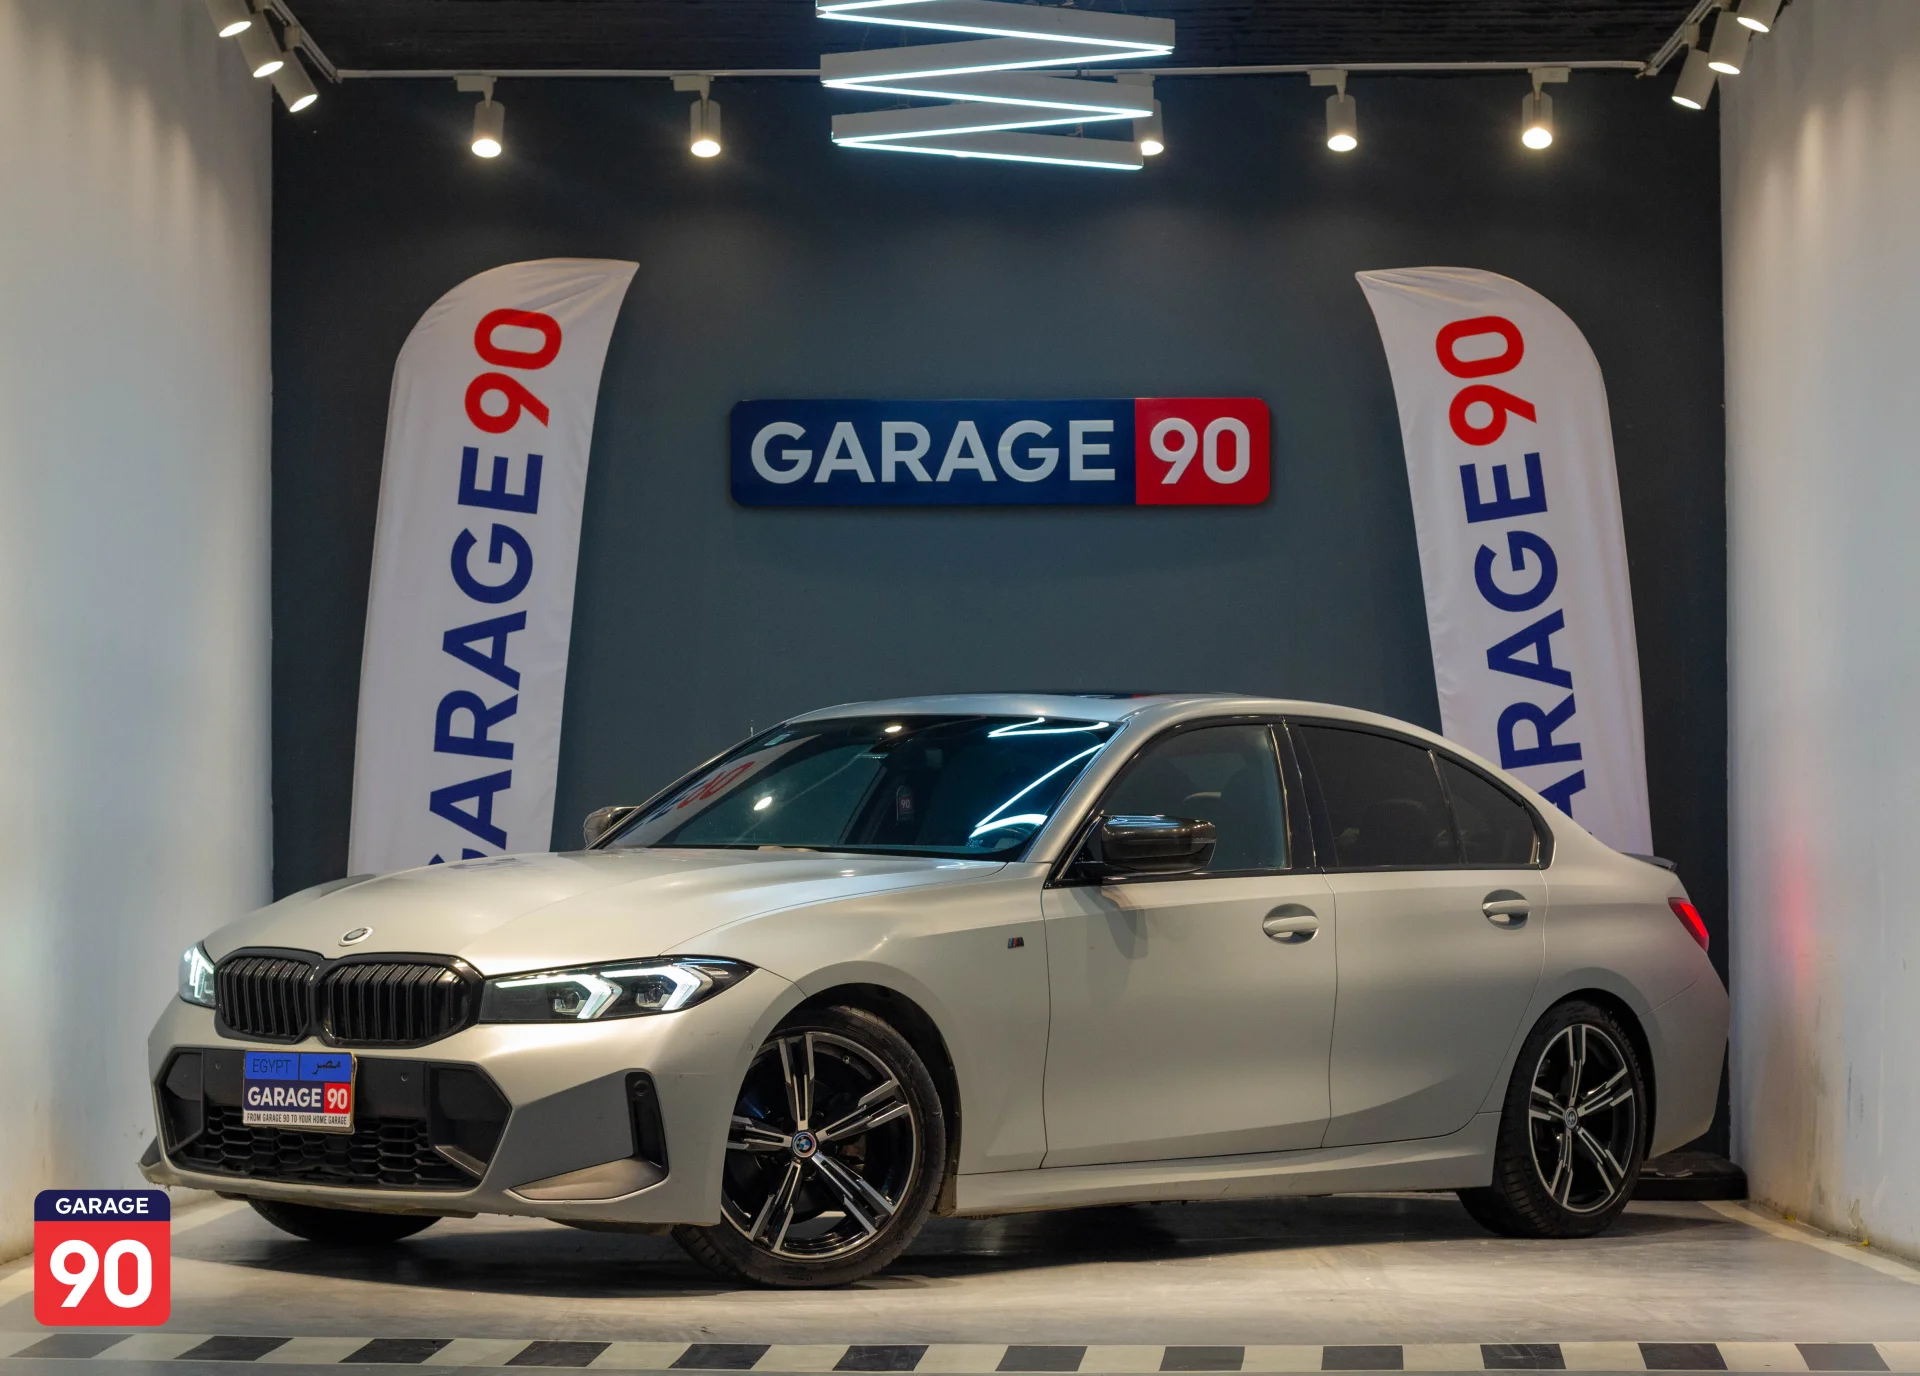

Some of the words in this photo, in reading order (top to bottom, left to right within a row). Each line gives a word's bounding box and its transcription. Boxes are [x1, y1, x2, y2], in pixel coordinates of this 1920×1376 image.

[751, 419, 1116, 484] GARAGE
[1149, 416, 1250, 485] 90
[429, 446, 544, 866] ARAGE
[252, 1058, 291, 1074] EGYPT
[312, 1059, 341, 1075] مصر
[247, 1086, 322, 1108] GARAGE
[327, 1088, 348, 1110] 90
[247, 1112, 261, 1121] FROM
[262, 1113, 282, 1123] GARAGE
[283, 1114, 290, 1123] 90
[291, 1115, 298, 1123] TO
[299, 1115, 311, 1124] YOUR
[312, 1115, 327, 1125] HOME
[328, 1116, 347, 1126] GARAGE
